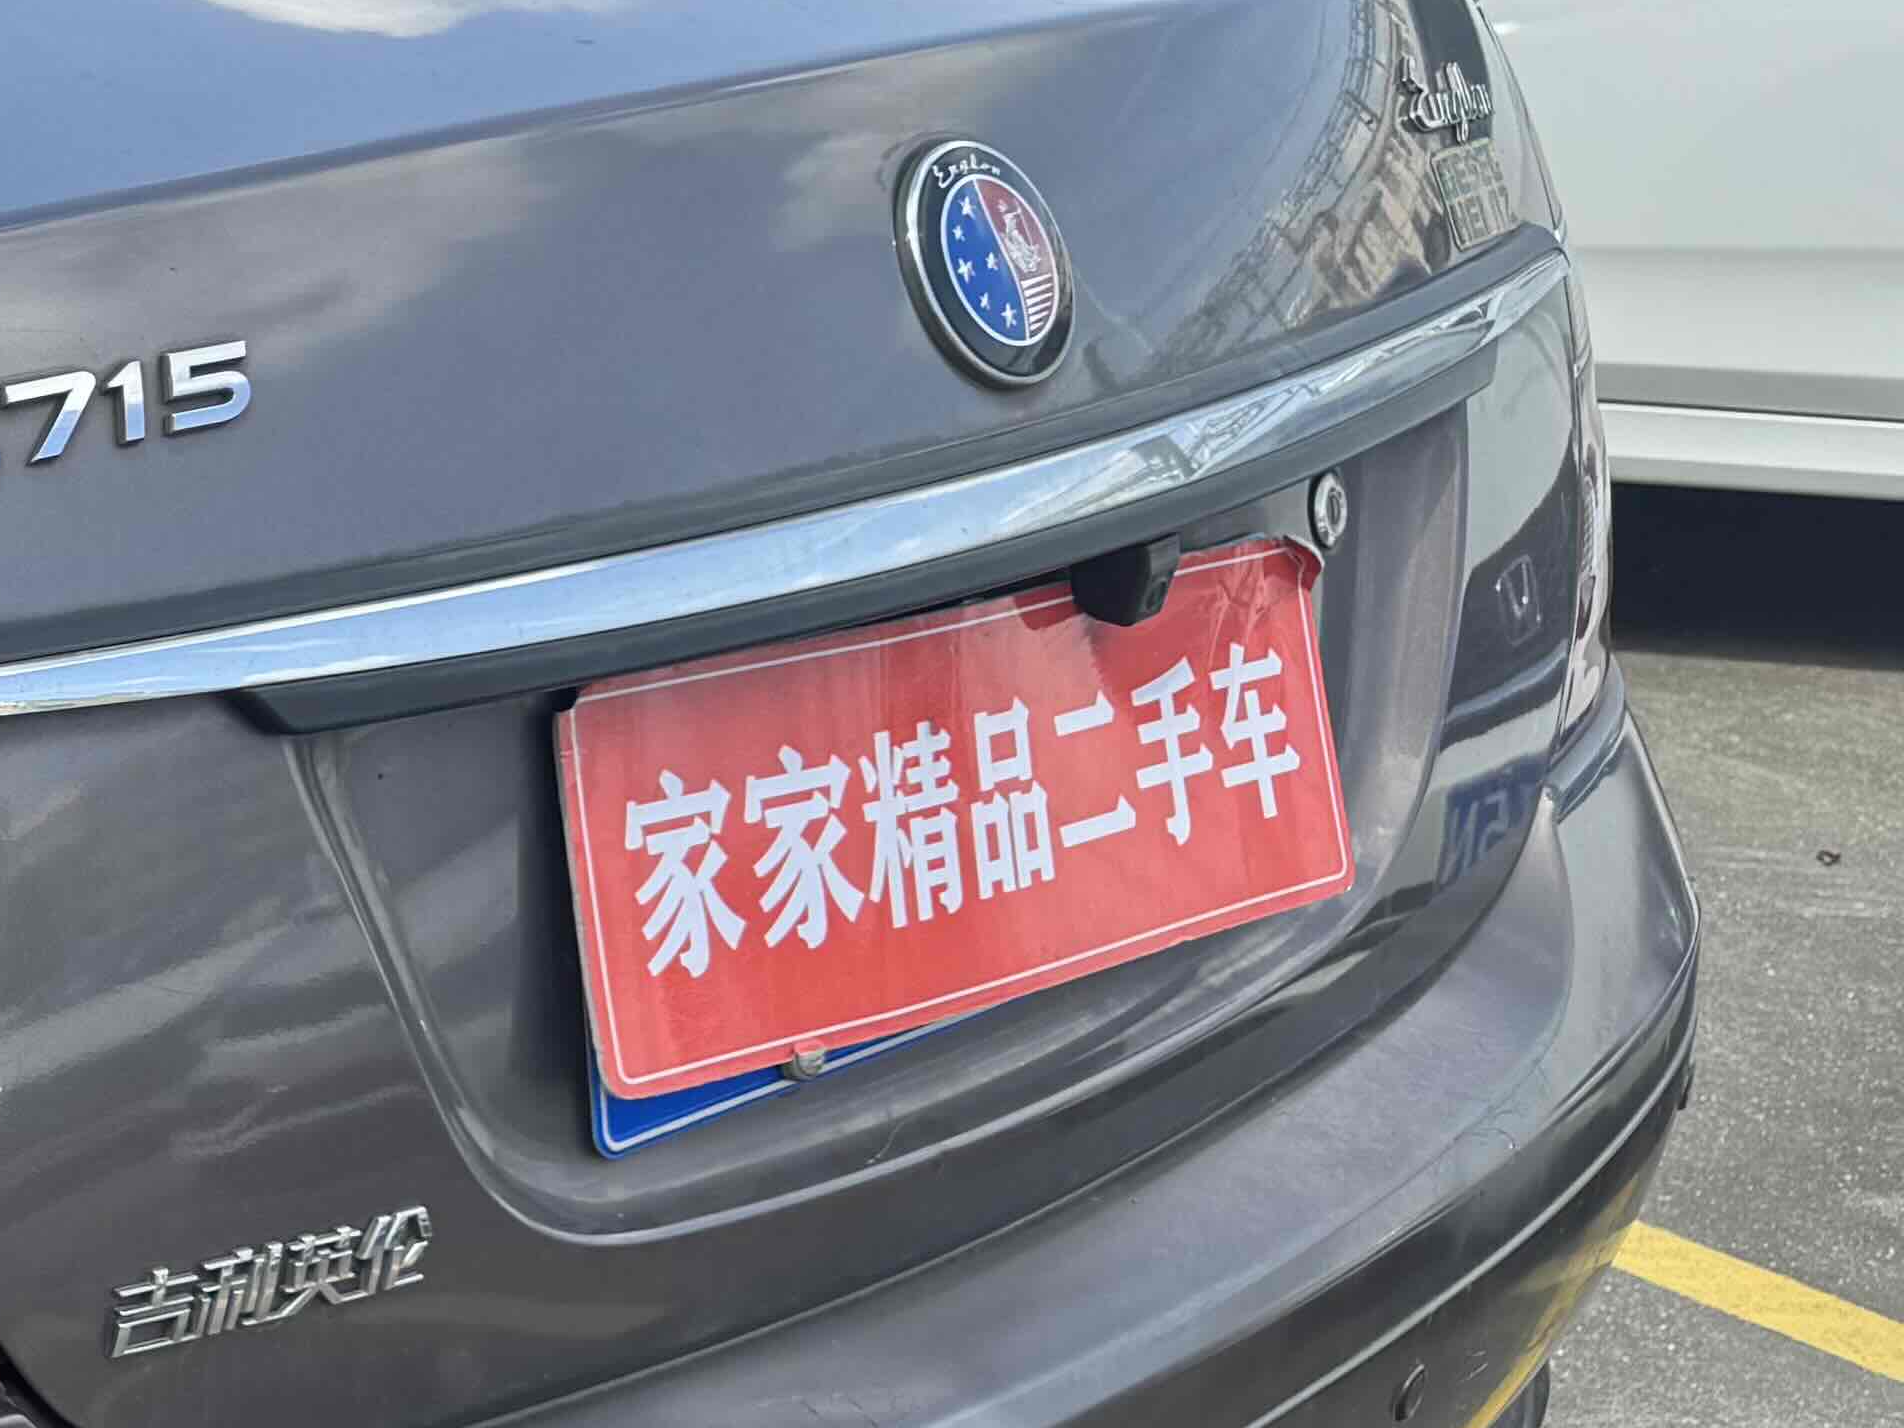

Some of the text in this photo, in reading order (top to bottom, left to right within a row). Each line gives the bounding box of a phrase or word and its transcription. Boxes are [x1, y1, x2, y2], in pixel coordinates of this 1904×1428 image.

[624, 643, 1301, 978] 家家精品二手车
[110, 1206, 433, 1358] 吉利英伦
